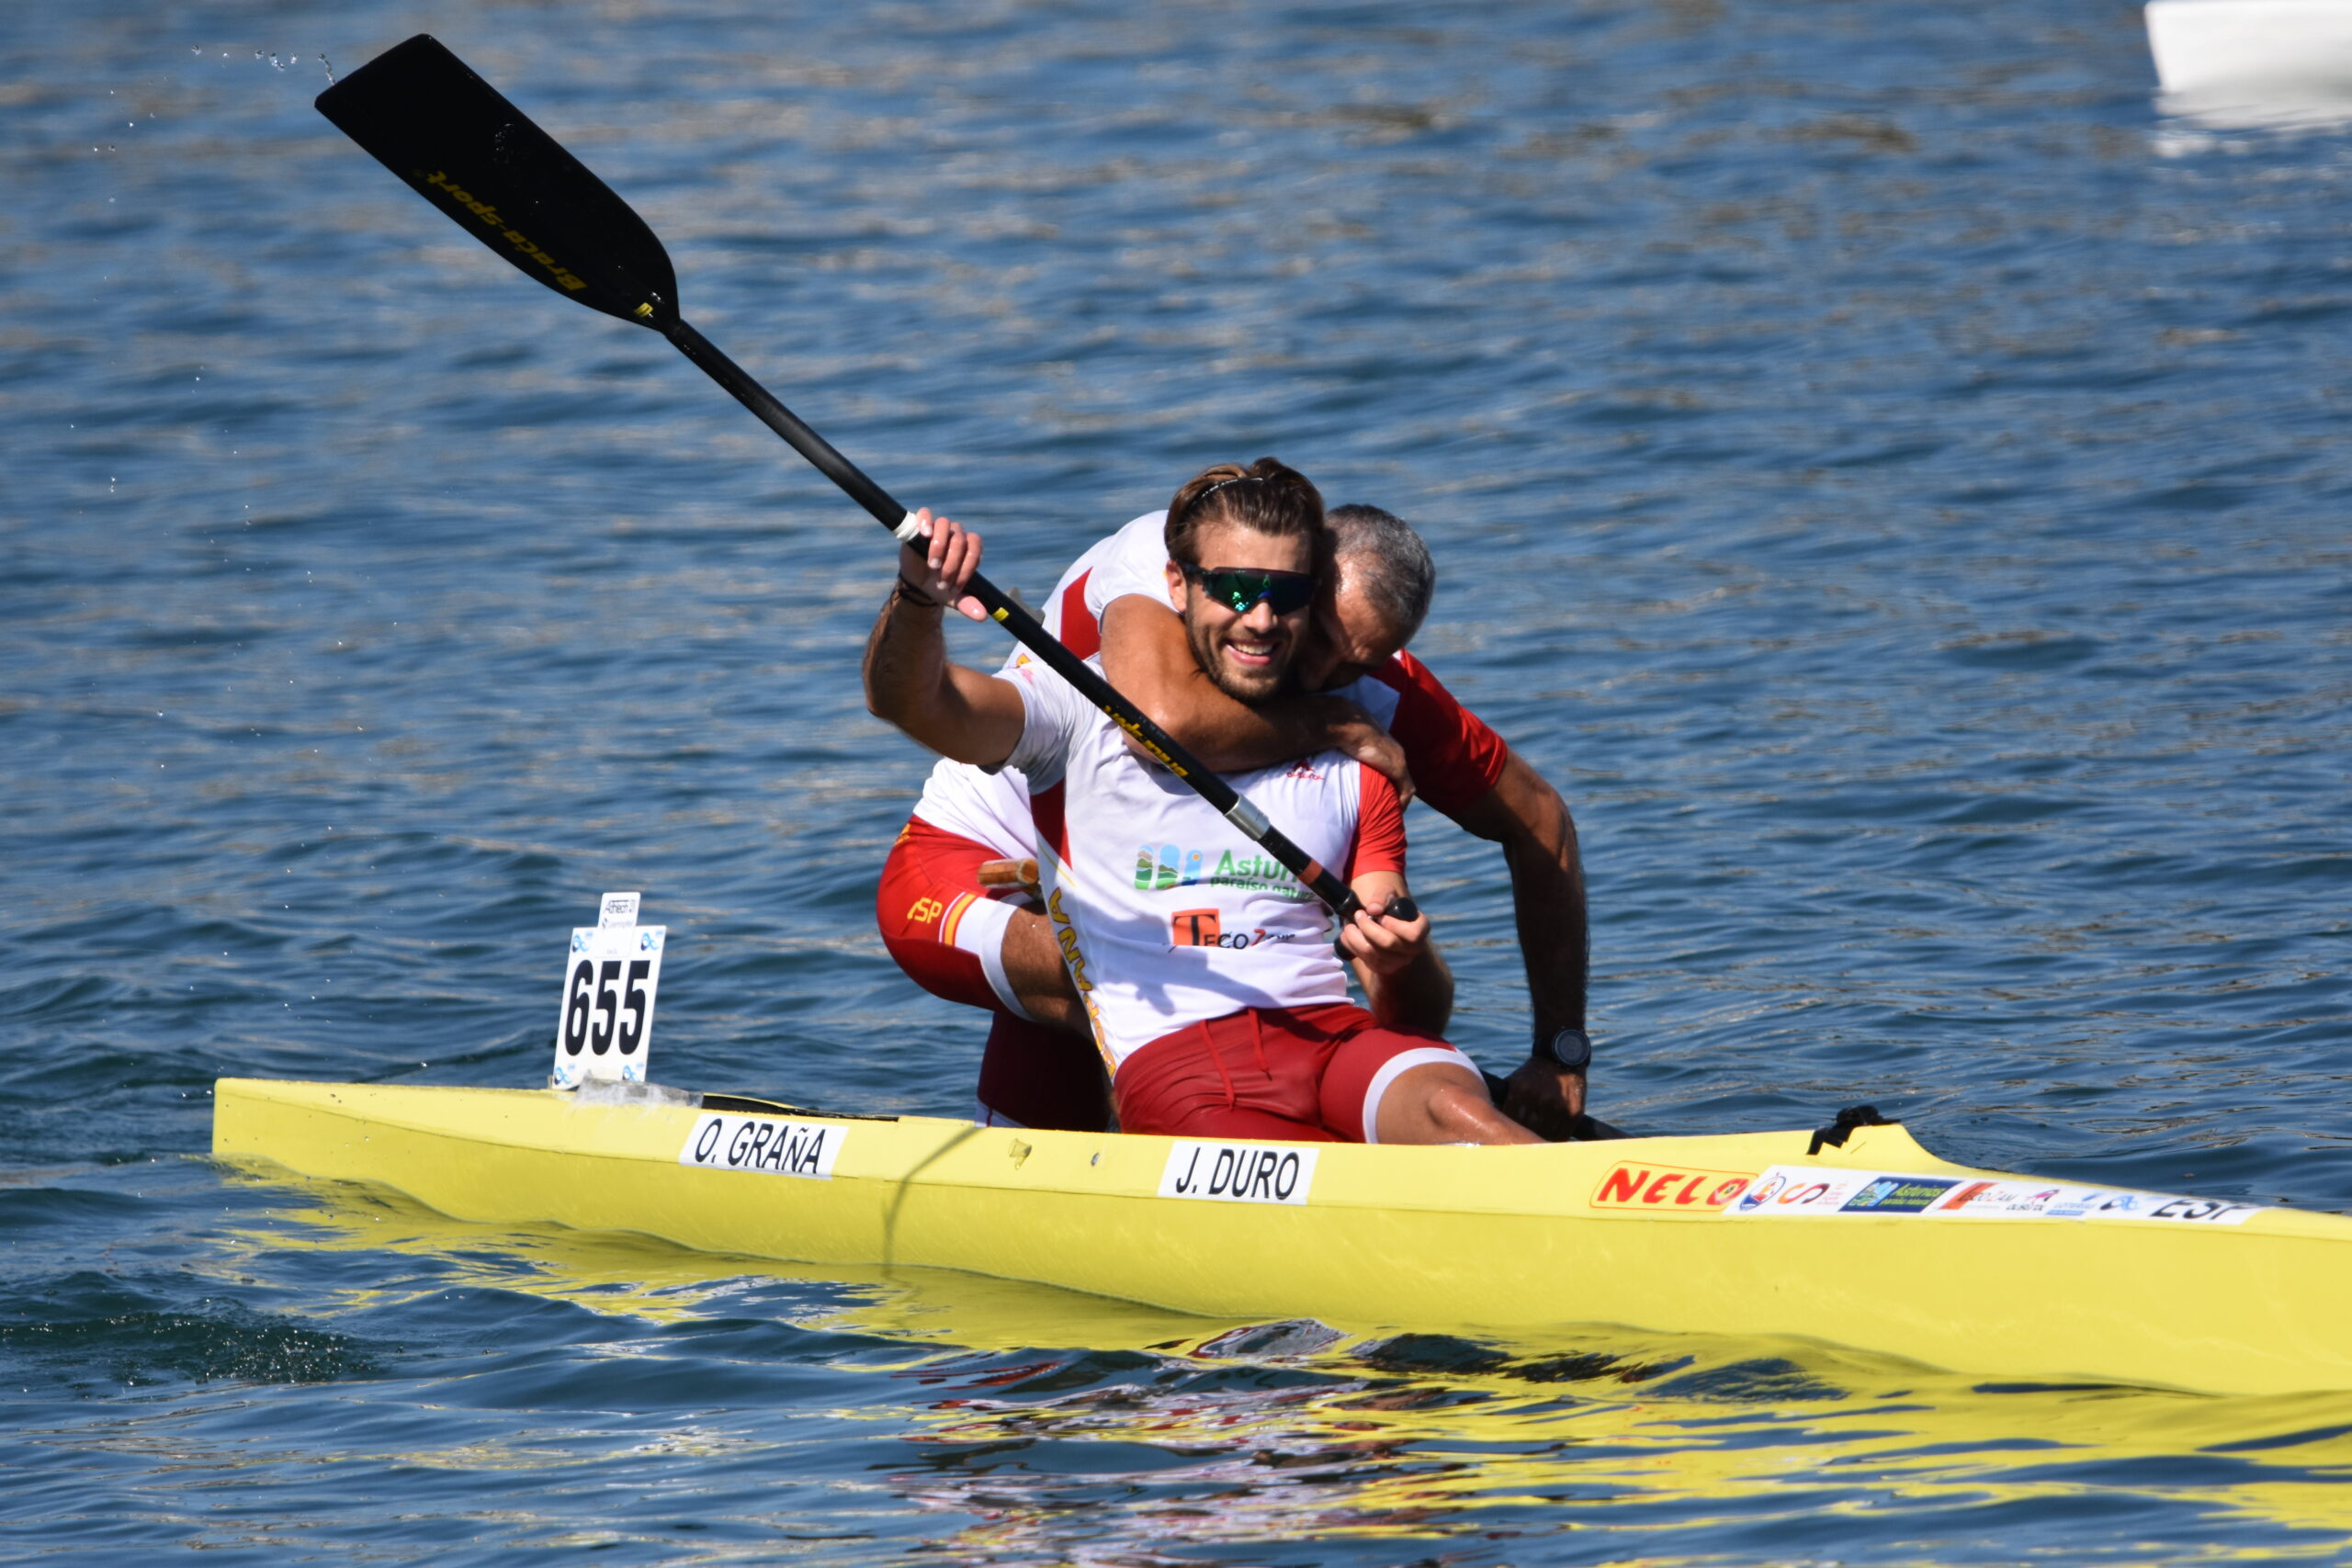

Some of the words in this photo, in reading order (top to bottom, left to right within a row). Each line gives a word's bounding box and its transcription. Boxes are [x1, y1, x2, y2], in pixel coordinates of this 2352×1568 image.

[565, 960, 650, 1056] 655
[695, 1118, 722, 1164] O.
[728, 1121, 826, 1174] GRAÑA
[1176, 1147, 1201, 1193] J.
[1208, 1148, 1299, 1200] DURO
[1597, 1168, 1749, 1206] NELO
